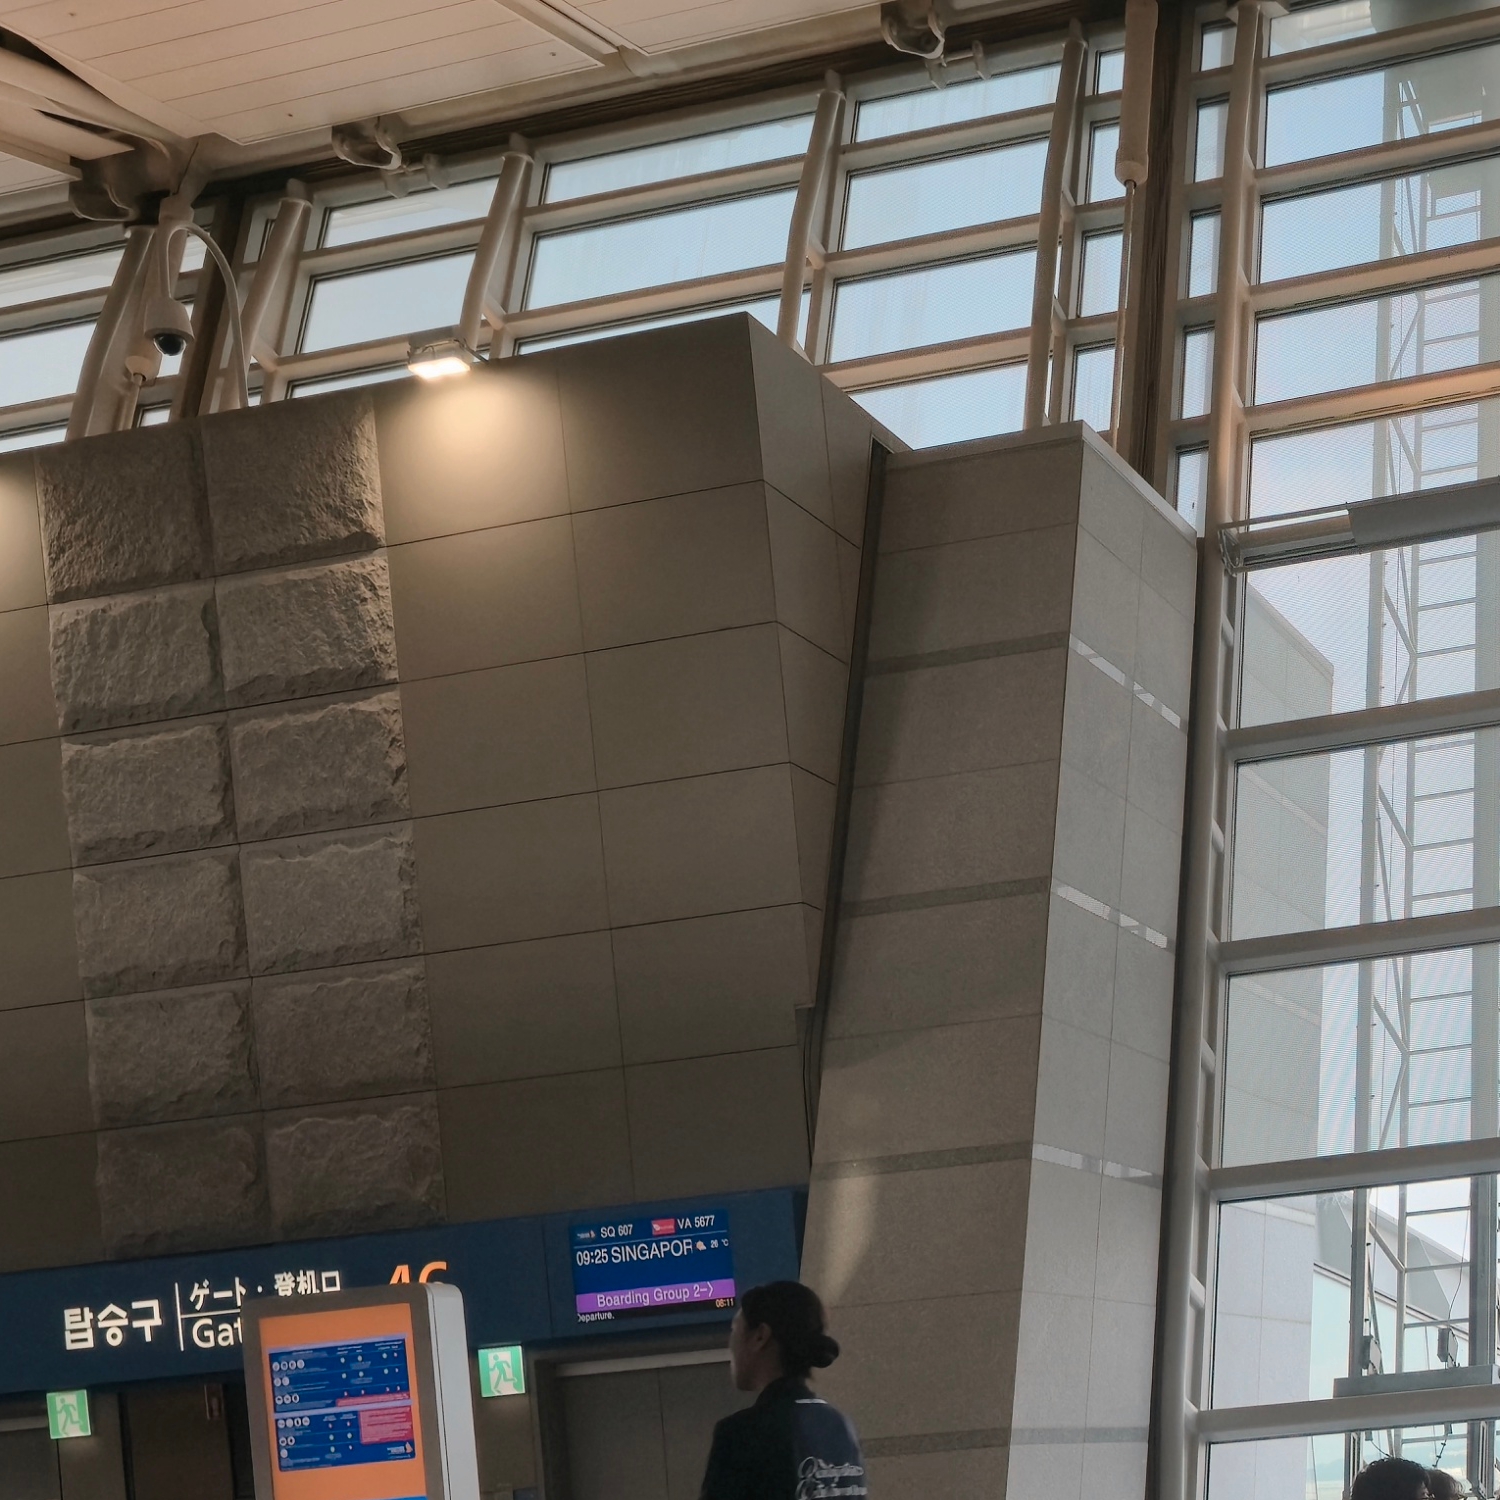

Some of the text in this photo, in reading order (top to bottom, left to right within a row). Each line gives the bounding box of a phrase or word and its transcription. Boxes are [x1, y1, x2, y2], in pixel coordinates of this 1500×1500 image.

[600, 1226, 616, 1238] SQ
[618, 1224, 634, 1236] 607
[677, 1218, 692, 1230] VA
[576, 1251, 609, 1266] 09:25
[597, 1287, 650, 1308] Boarding
[654, 1287, 690, 1303] Group
[63, 1298, 163, 1351] 탑승구
[192, 1317, 243, 1349] Gat
